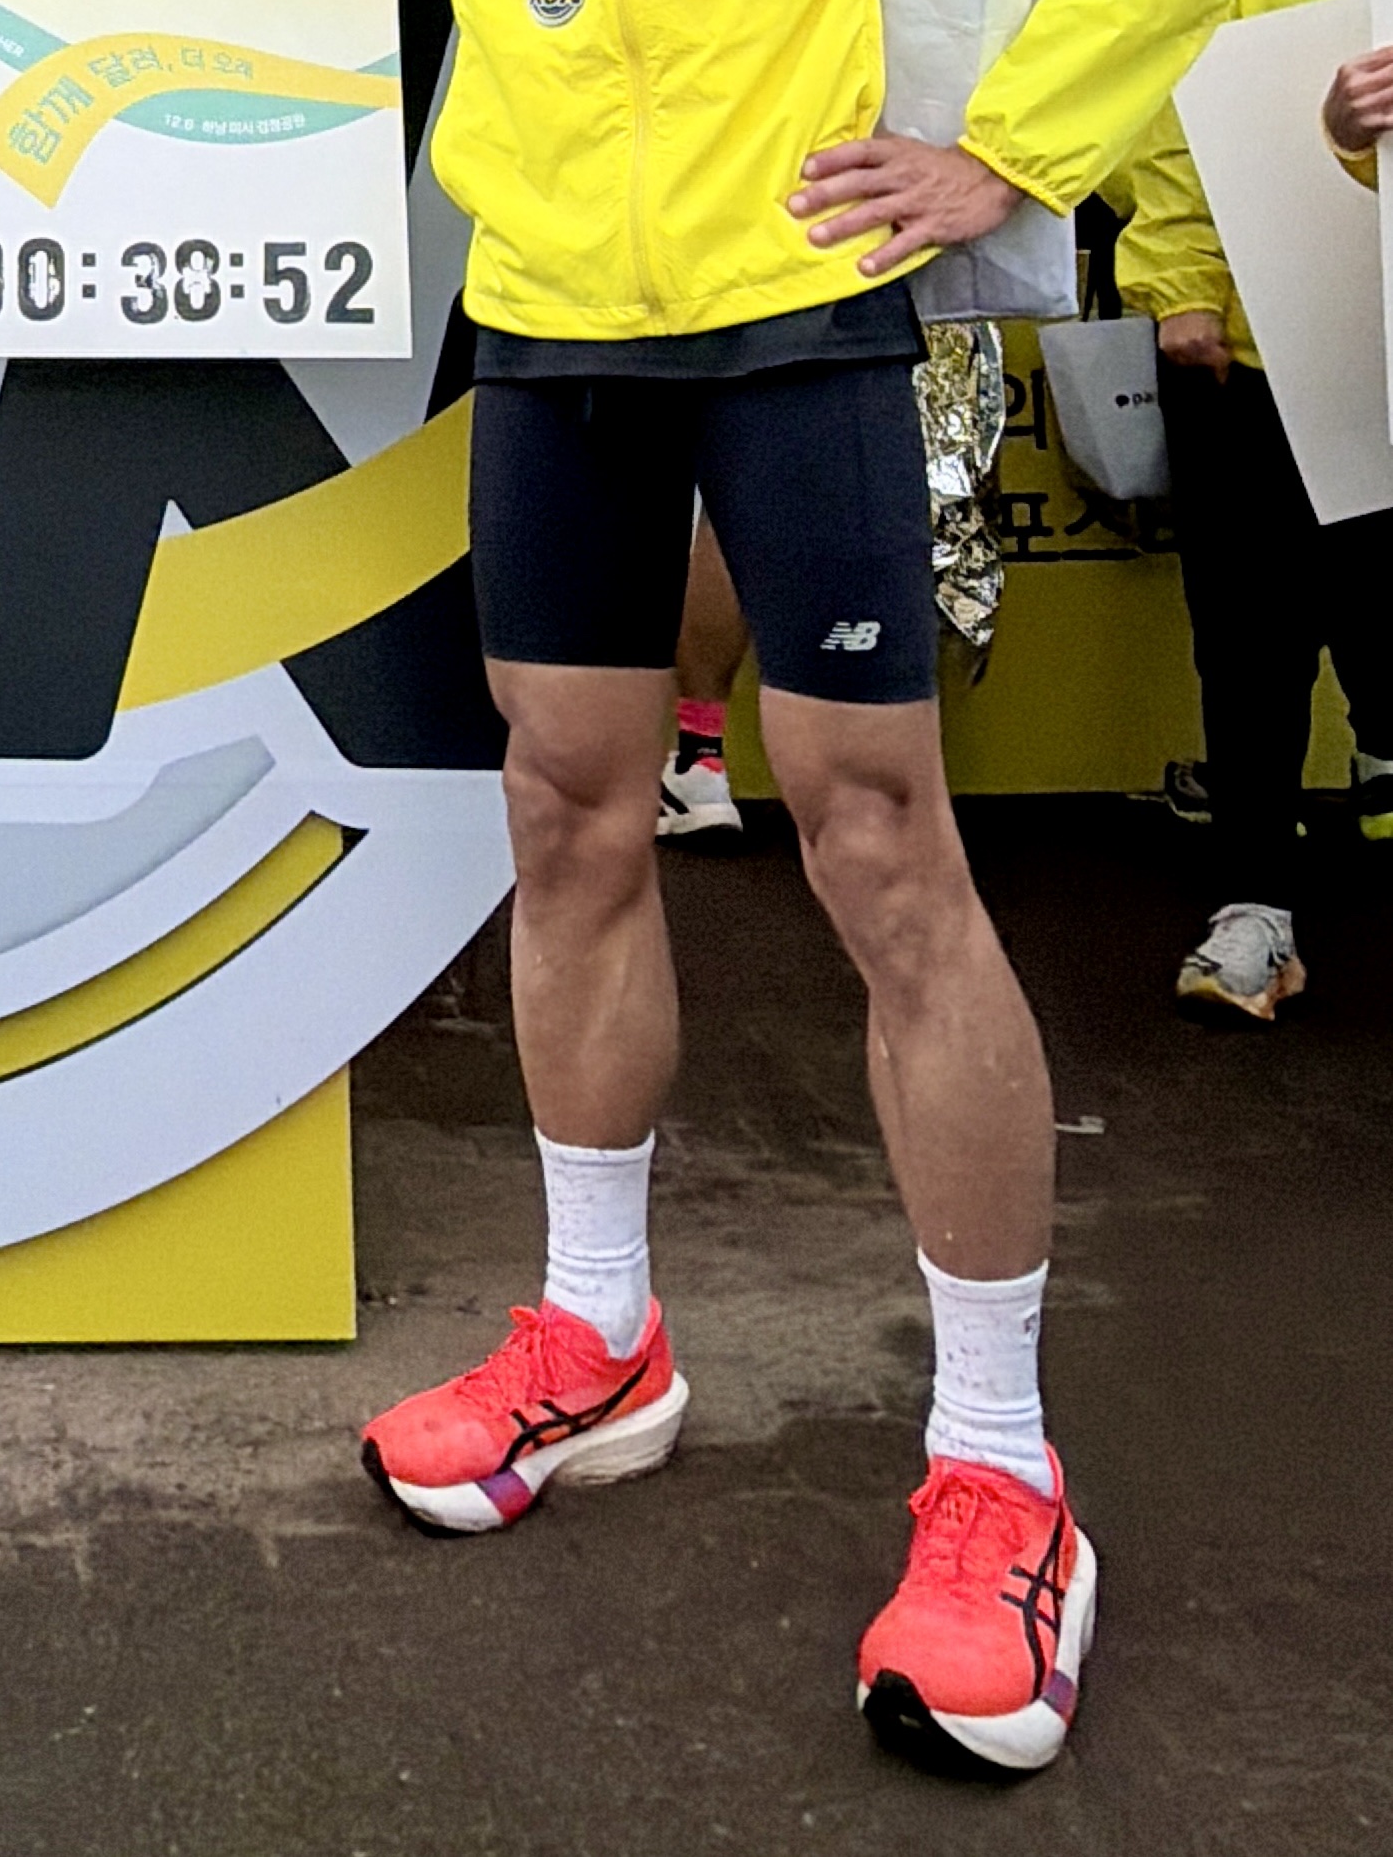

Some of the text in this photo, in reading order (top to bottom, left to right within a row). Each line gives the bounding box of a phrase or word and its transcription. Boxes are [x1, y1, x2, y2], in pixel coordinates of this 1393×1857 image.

[7, 75, 95, 165] 함께
[180, 46, 205, 72] 더
[212, 51, 254, 81] 오래
[1132, 391, 1156, 407] pa
